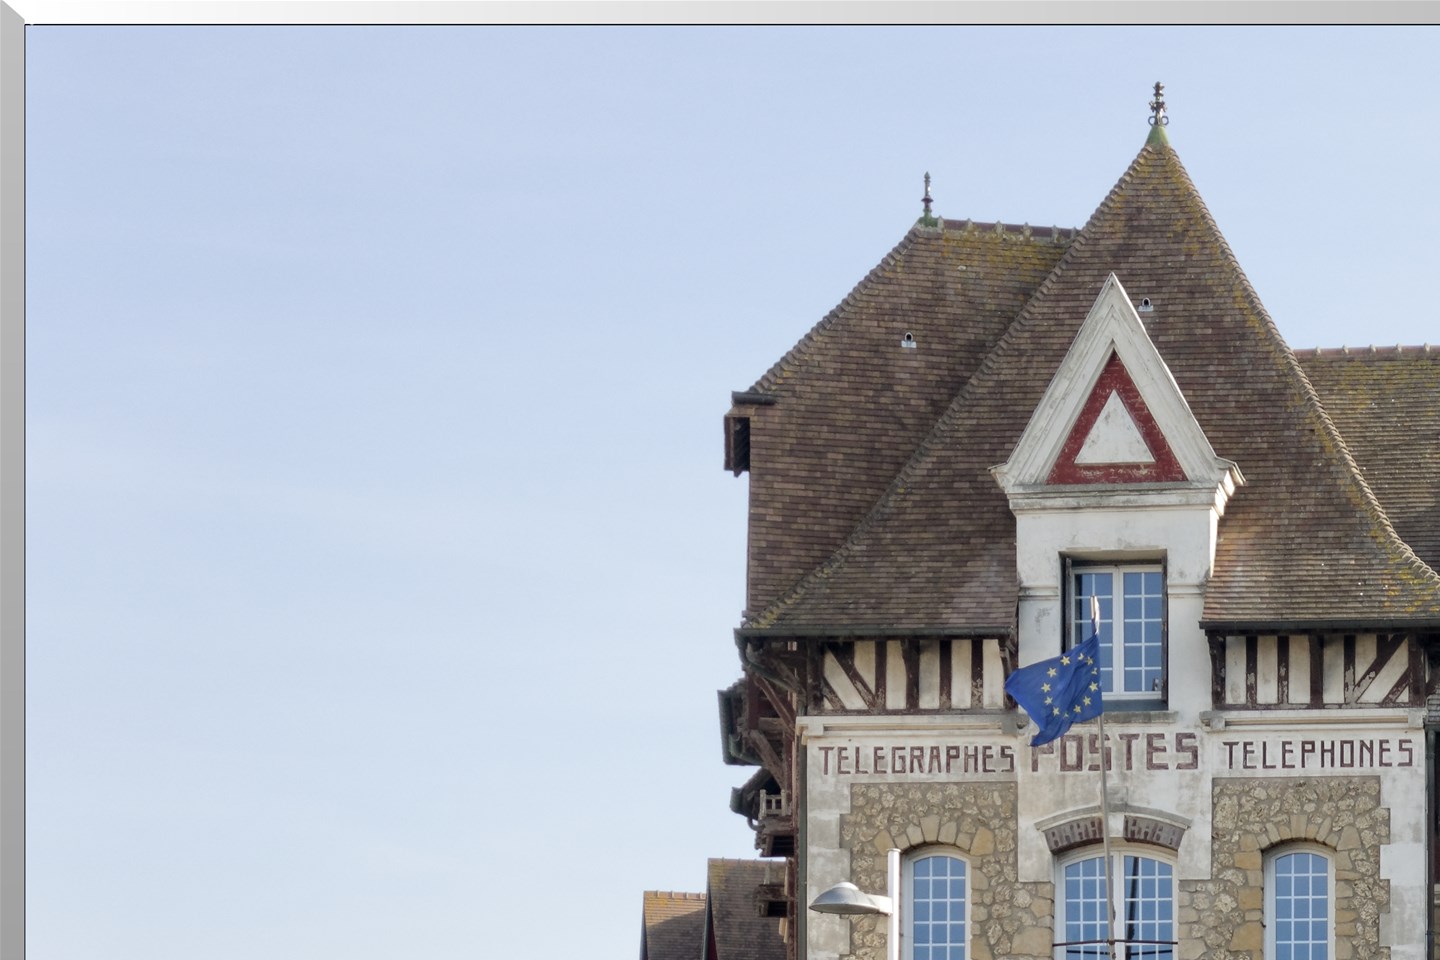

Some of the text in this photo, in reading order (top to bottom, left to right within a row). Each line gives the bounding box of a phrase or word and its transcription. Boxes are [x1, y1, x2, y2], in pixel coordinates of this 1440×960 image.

[817, 745, 1015, 775] TELEGRAPHES
[1030, 732, 1199, 772] POSTES
[1222, 739, 1414, 770] TELEPHONES
